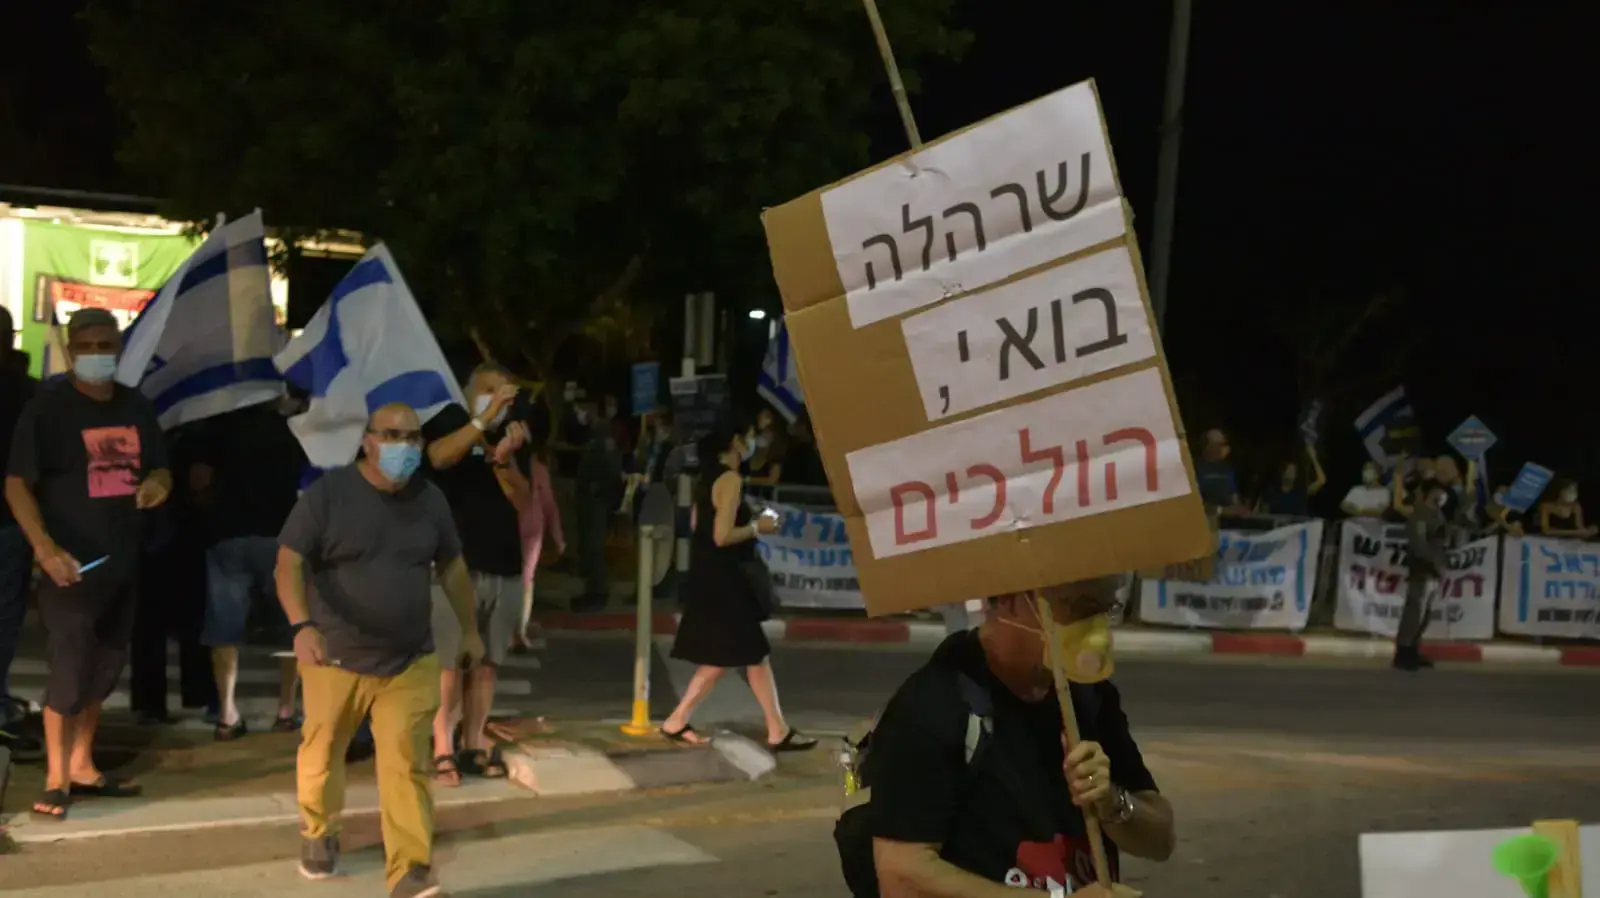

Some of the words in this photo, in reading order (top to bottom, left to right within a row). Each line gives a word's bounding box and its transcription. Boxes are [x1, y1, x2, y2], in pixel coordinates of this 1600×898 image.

[861, 151, 1091, 290] שרהלה
[938, 286, 1128, 413] בואי,
[890, 426, 1159, 546] הולכים
